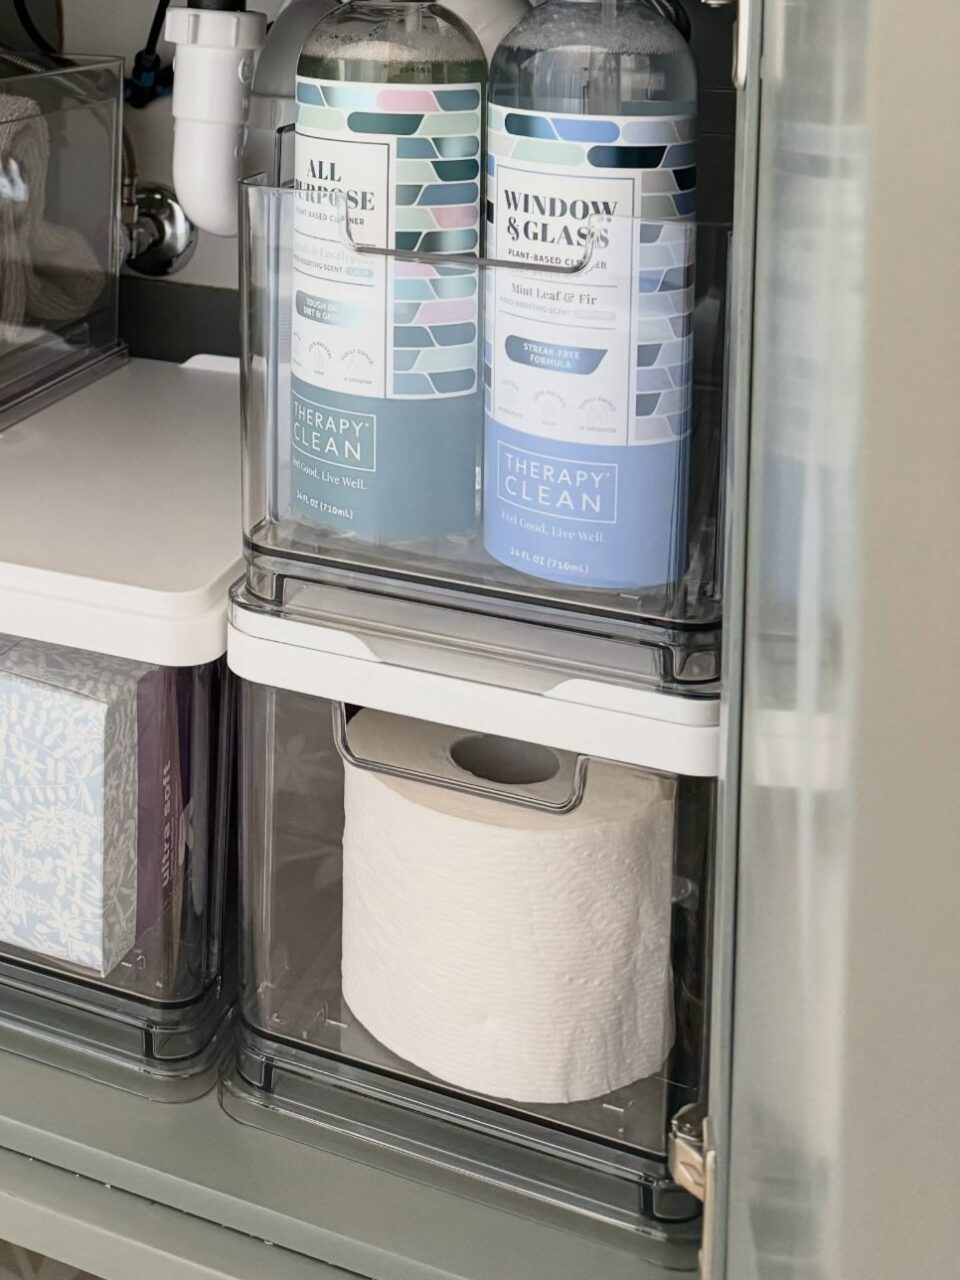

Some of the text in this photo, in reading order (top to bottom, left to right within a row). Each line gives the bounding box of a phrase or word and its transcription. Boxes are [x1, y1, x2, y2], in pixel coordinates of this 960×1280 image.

[306, 159, 342, 182] ALL
[504, 189, 618, 222] WINDOW
[323, 263, 343, 273] SCENT
[508, 248, 562, 265] PLANT-BASED
[306, 297, 327, 310] TOUGH
[511, 282, 533, 298] Mint
[536, 288, 561, 302] Leaf
[578, 293, 598, 306] Fir
[523, 342, 580, 360] STREAK-FREE
[529, 355, 572, 369] FORMULA
[294, 401, 364, 438] THERAPY
[293, 421, 361, 461] CLEAN
[321, 471, 340, 486] Live
[505, 452, 604, 488] THERAPY
[505, 475, 601, 513] CLEAN
[310, 498, 319, 509] OZ
[320, 501, 353, 520] (710mL)
[519, 514, 548, 535] Good.
[552, 525, 576, 541] Live
[578, 529, 607, 544] Well.
[510, 546, 590, 574] 24 FL OZ (710mL)
[161, 759, 171, 888] ultra soft
